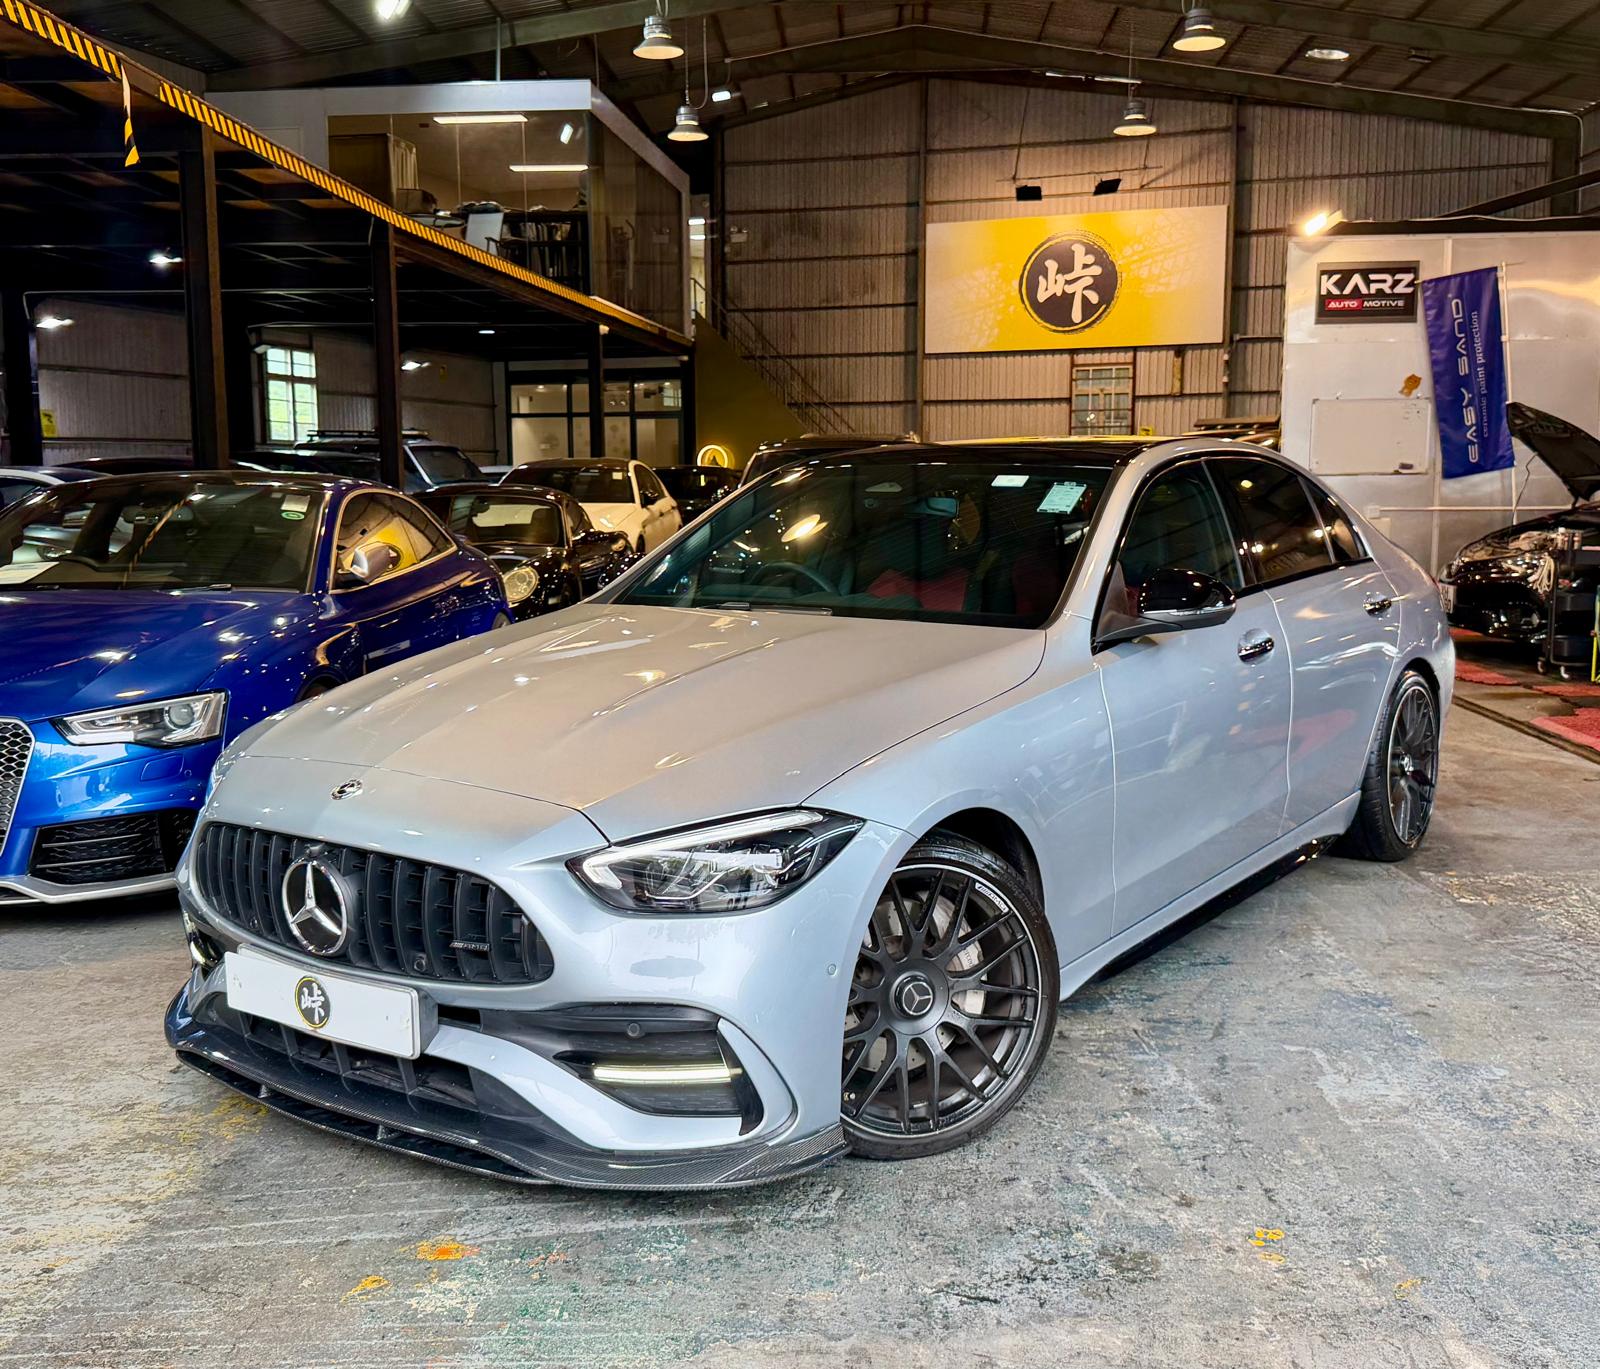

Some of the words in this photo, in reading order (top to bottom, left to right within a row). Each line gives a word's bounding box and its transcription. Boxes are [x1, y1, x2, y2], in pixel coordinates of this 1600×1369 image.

[1036, 242, 1103, 323] 峠
[1320, 273, 1415, 295] KARZ
[1451, 299, 1469, 376] SAND
[1471, 311, 1486, 364] protection
[1477, 365, 1487, 394] paint
[1460, 387, 1479, 463] EASY
[301, 983, 325, 1024] 峠
